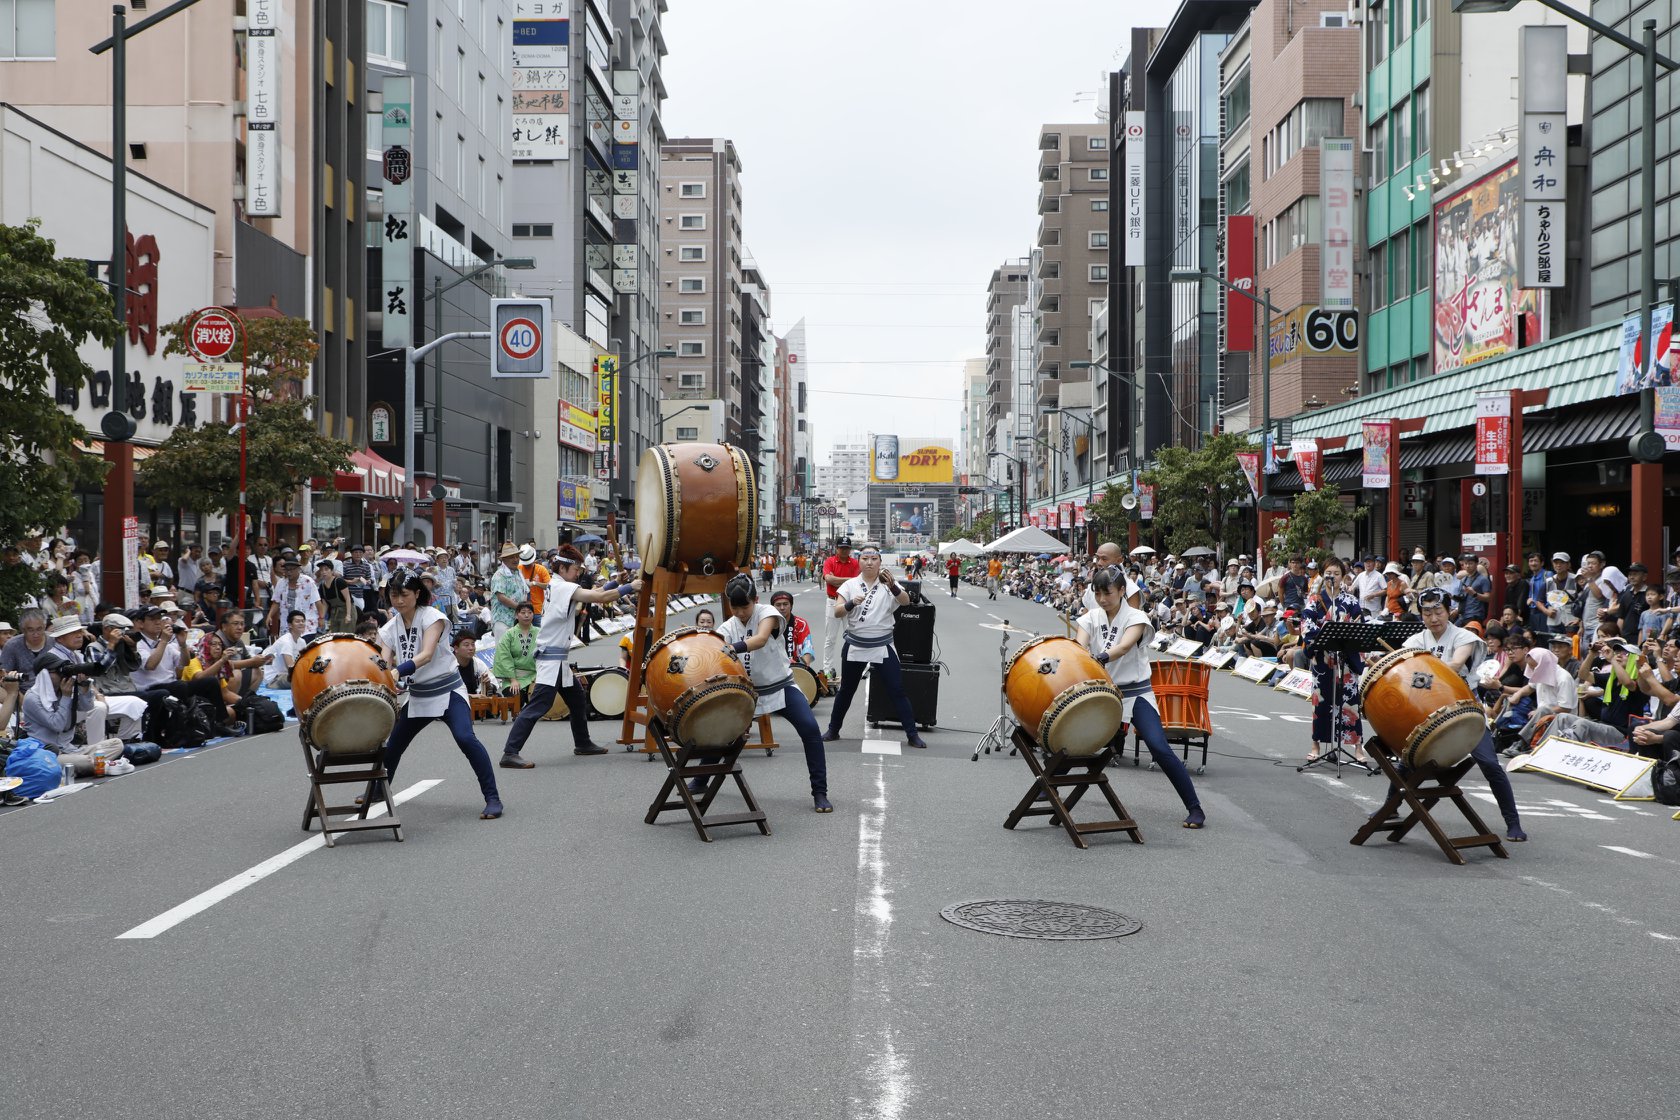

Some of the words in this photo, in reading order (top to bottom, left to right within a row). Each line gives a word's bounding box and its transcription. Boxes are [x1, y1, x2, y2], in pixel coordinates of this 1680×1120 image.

[520, 27, 537, 36] BED
[254, 90, 268, 118] 七色
[1533, 146, 1557, 192] 舟和
[254, 184, 268, 211] 七色
[1130, 165, 1141, 239] 三菱UFJ銀行
[1327, 187, 1349, 289] ヨーロー堂
[1537, 205, 1551, 283] ちゃんこ部屋
[197, 327, 231, 344] 消火栓
[510, 329, 532, 348] 40
[1485, 430, 1498, 462] 生中継
